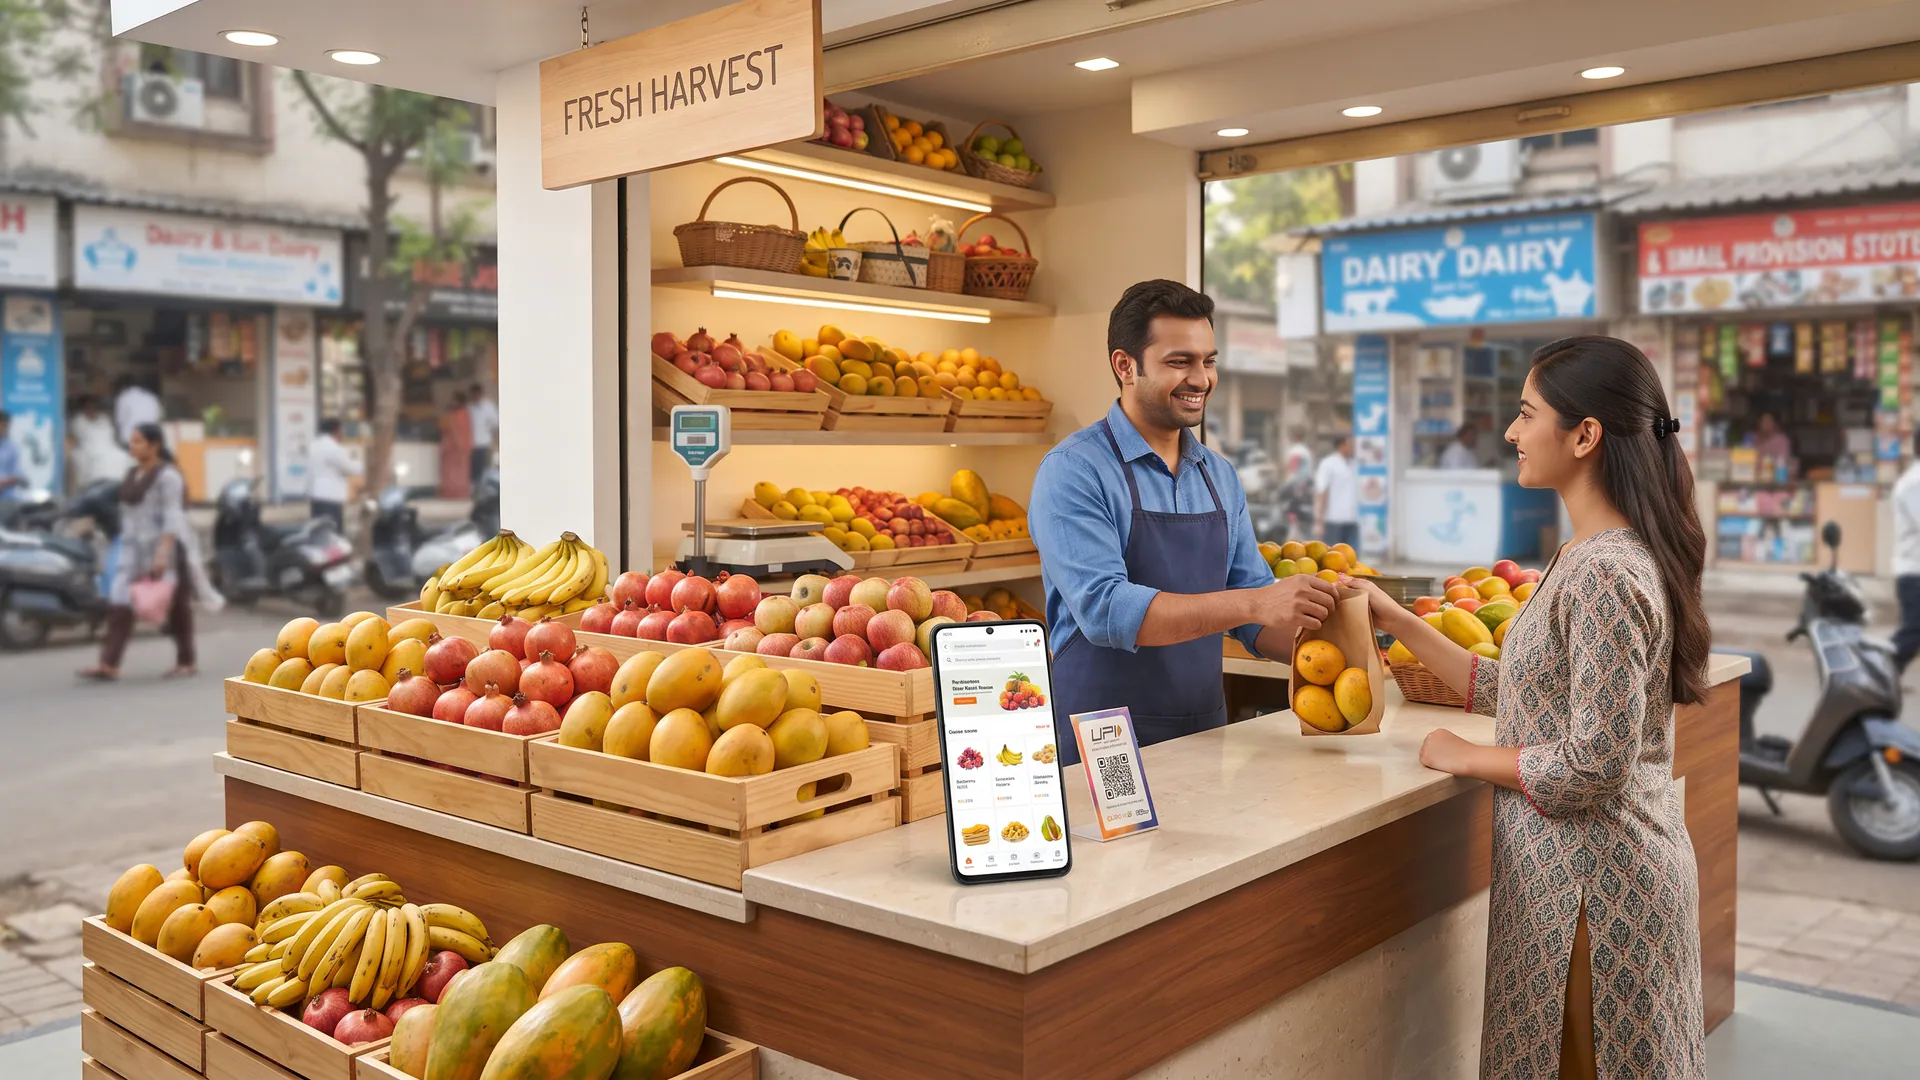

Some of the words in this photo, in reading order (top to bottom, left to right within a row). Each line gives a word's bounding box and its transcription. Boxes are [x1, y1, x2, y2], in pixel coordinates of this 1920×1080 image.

[563, 81, 643, 136] FRESH
[651, 43, 784, 114] HARVEST
[1341, 250, 1446, 287] DAIRY
[1456, 237, 1573, 278] DAIRY
[1732, 235, 1848, 269] PROVISION
[1091, 725, 1118, 742] UPI
